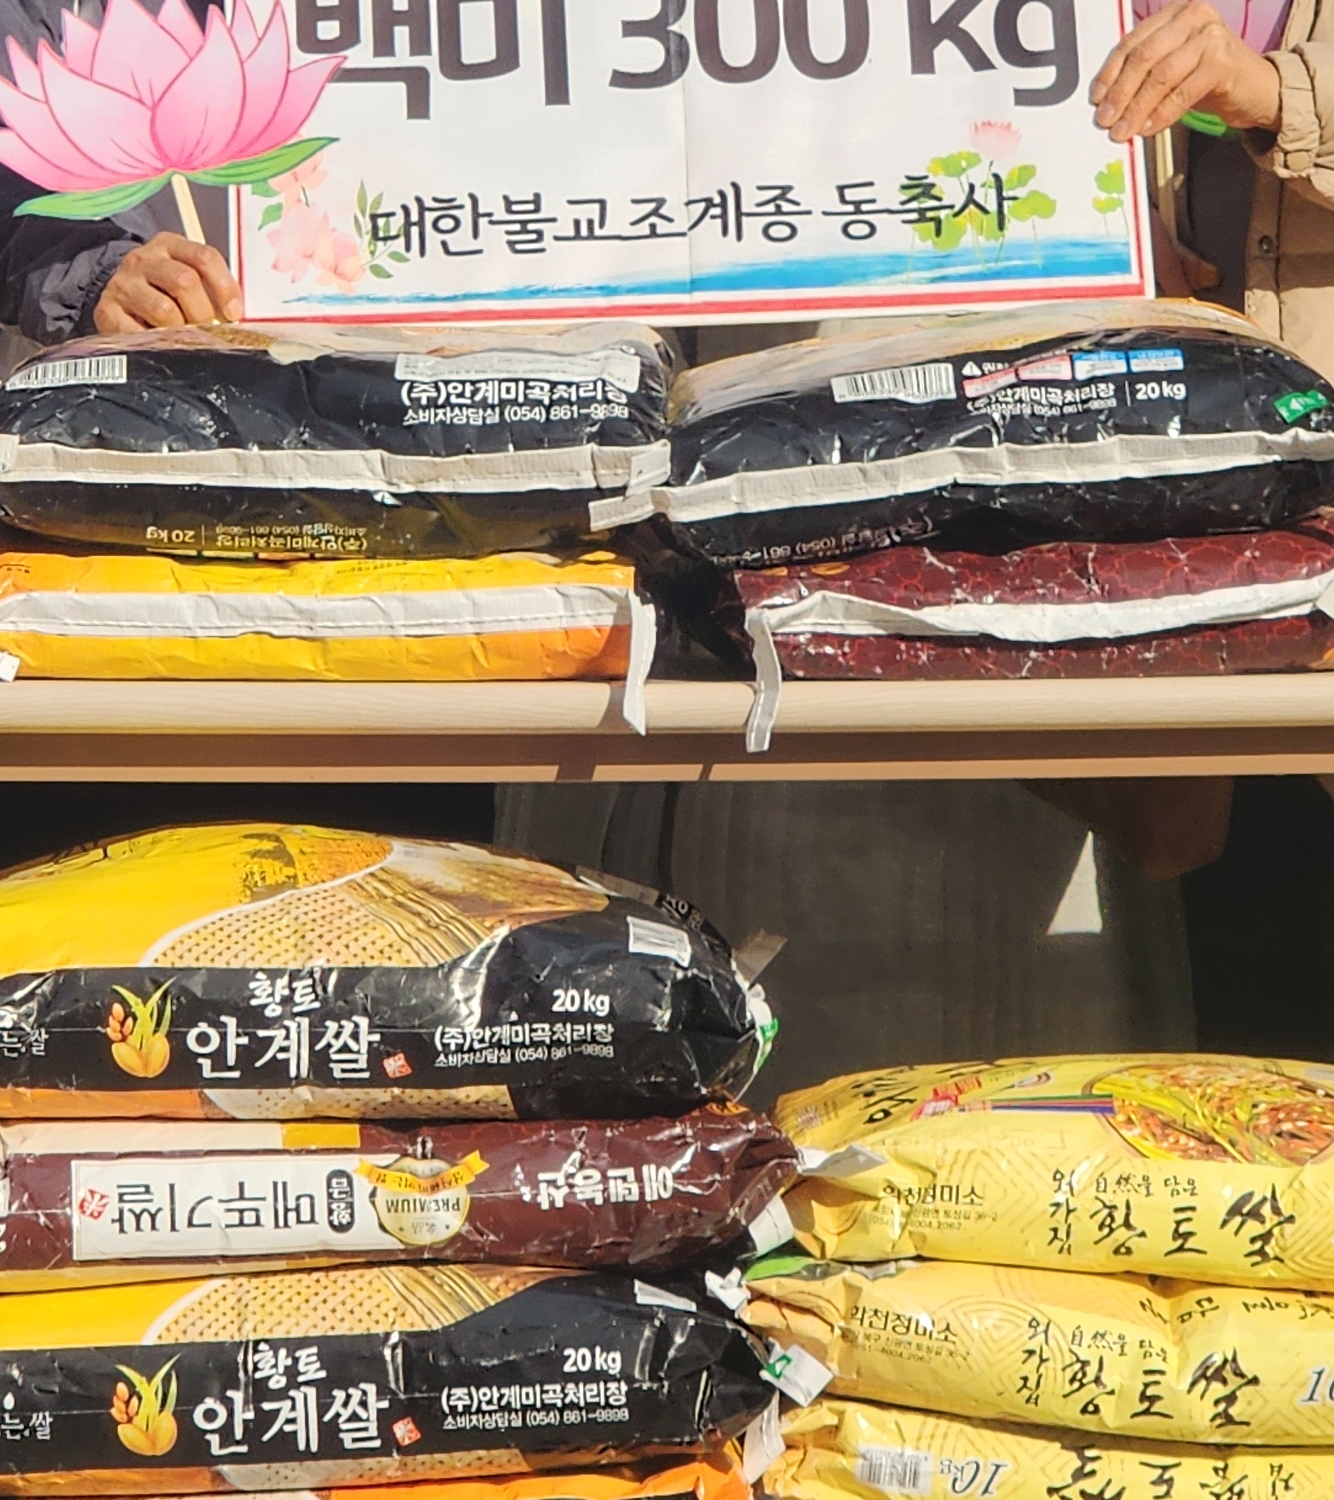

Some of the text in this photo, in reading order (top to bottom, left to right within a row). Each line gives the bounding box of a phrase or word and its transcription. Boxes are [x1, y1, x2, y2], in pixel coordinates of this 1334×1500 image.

[370, 172, 1020, 261] 대한불교조계종 동축사
[402, 403, 630, 426] 소비자상담실 (054) 861-9898
[216, 534, 368, 551] (주)안계미곡처리장
[249, 970, 321, 1017] 황토
[186, 1015, 382, 1080] 안계쌀
[434, 1022, 615, 1051] (주)안계미곡처리장
[434, 1043, 614, 1067] 소비자상담실 (054) 861-9898
[110, 1181, 320, 1235] 메뚜기쌀
[328, 1177, 352, 1226] 황금
[385, 1197, 461, 1214] PREMIUM
[537, 1164, 674, 1211] 에덴농산
[254, 1344, 327, 1391] 황토
[193, 1383, 390, 1457] 안계쌀
[440, 1380, 629, 1414] (주)안계미곡처리장
[443, 1407, 630, 1430] 소비자상담실 (054) 861-9898
